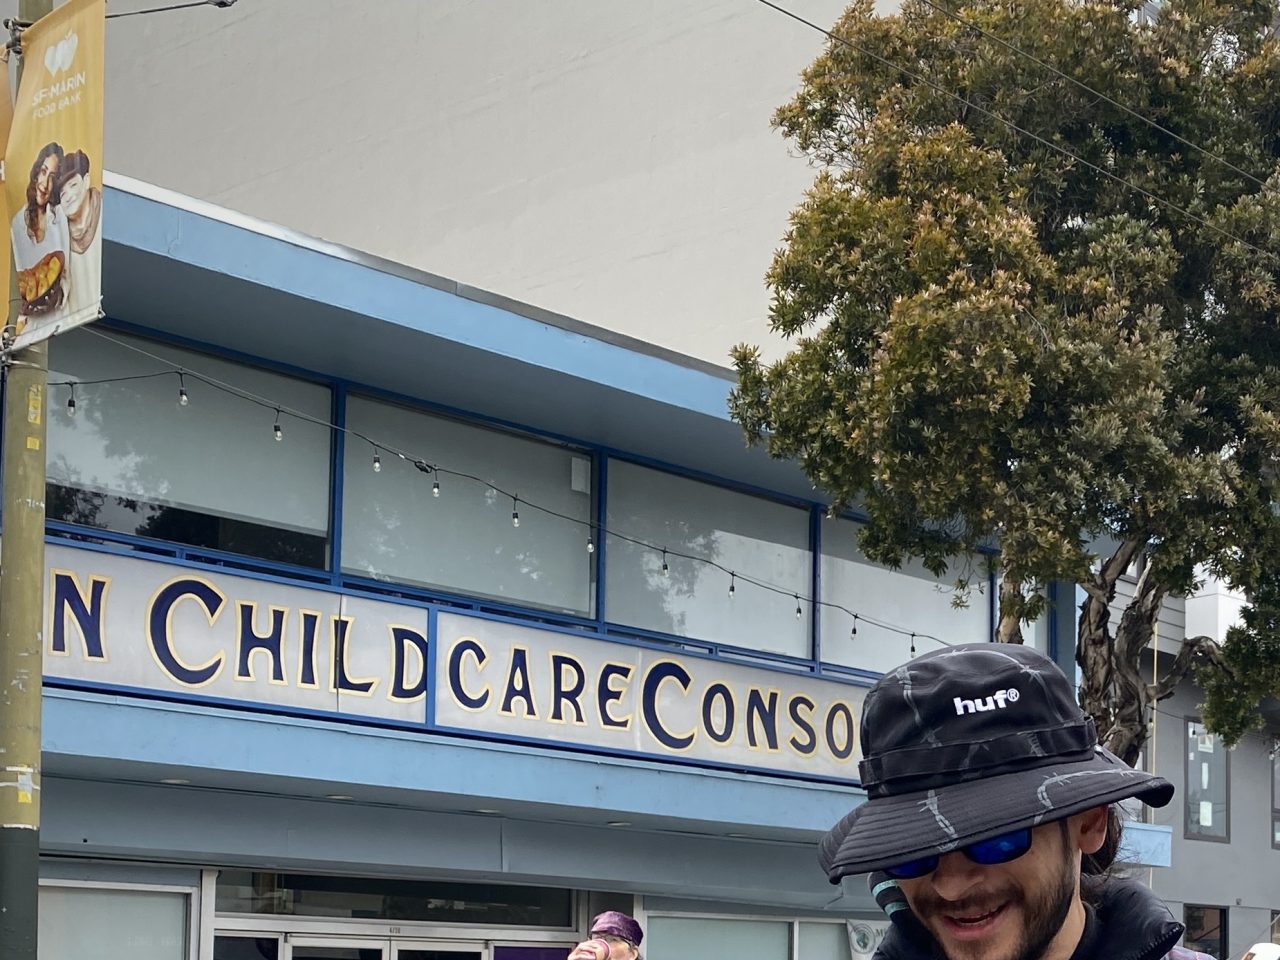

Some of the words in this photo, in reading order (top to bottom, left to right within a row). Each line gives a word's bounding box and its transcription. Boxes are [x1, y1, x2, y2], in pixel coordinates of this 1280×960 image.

[32, 71, 86, 107] SF-MARIN
[32, 101, 56, 119] FOOD
[58, 91, 82, 110] BANK
